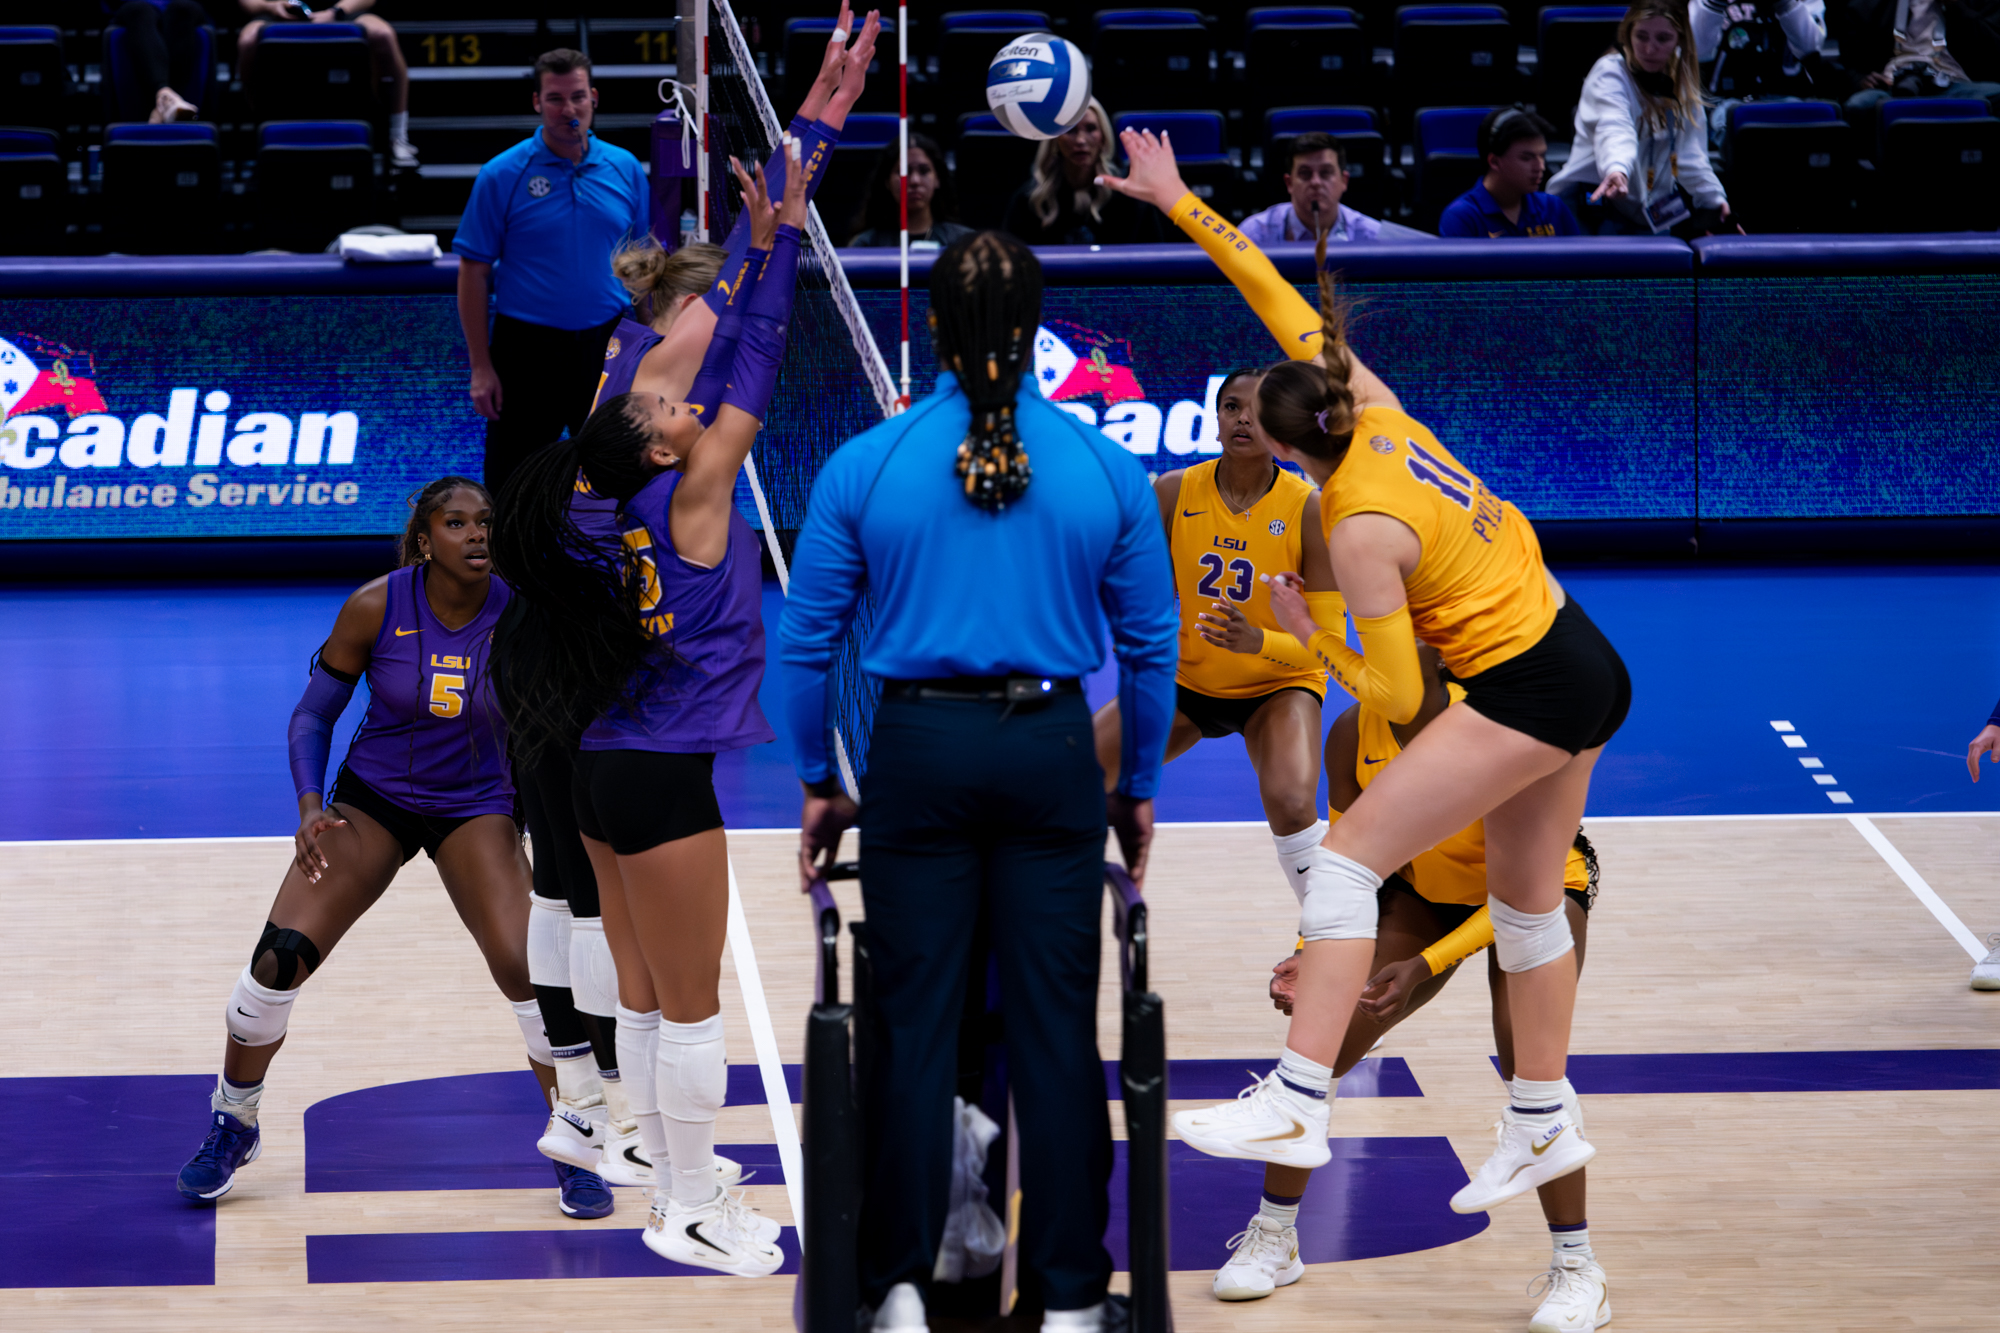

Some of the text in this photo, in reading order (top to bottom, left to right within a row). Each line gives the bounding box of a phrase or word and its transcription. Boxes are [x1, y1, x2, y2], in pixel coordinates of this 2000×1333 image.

[421, 34, 482, 64] 113
[634, 31, 677, 62] 11
[1188, 207, 1249, 252] GEAUX
[1405, 436, 1474, 512] 11
[186, 472, 360, 507] Service
[1267, 519, 1286, 536] SEC
[1213, 535, 1247, 551] LSU
[1197, 551, 1255, 603] 23
[430, 653, 471, 670] LSU
[428, 672, 465, 719] 5
[563, 1110, 585, 1127] LSU
[1542, 1122, 1564, 1141] LSU
